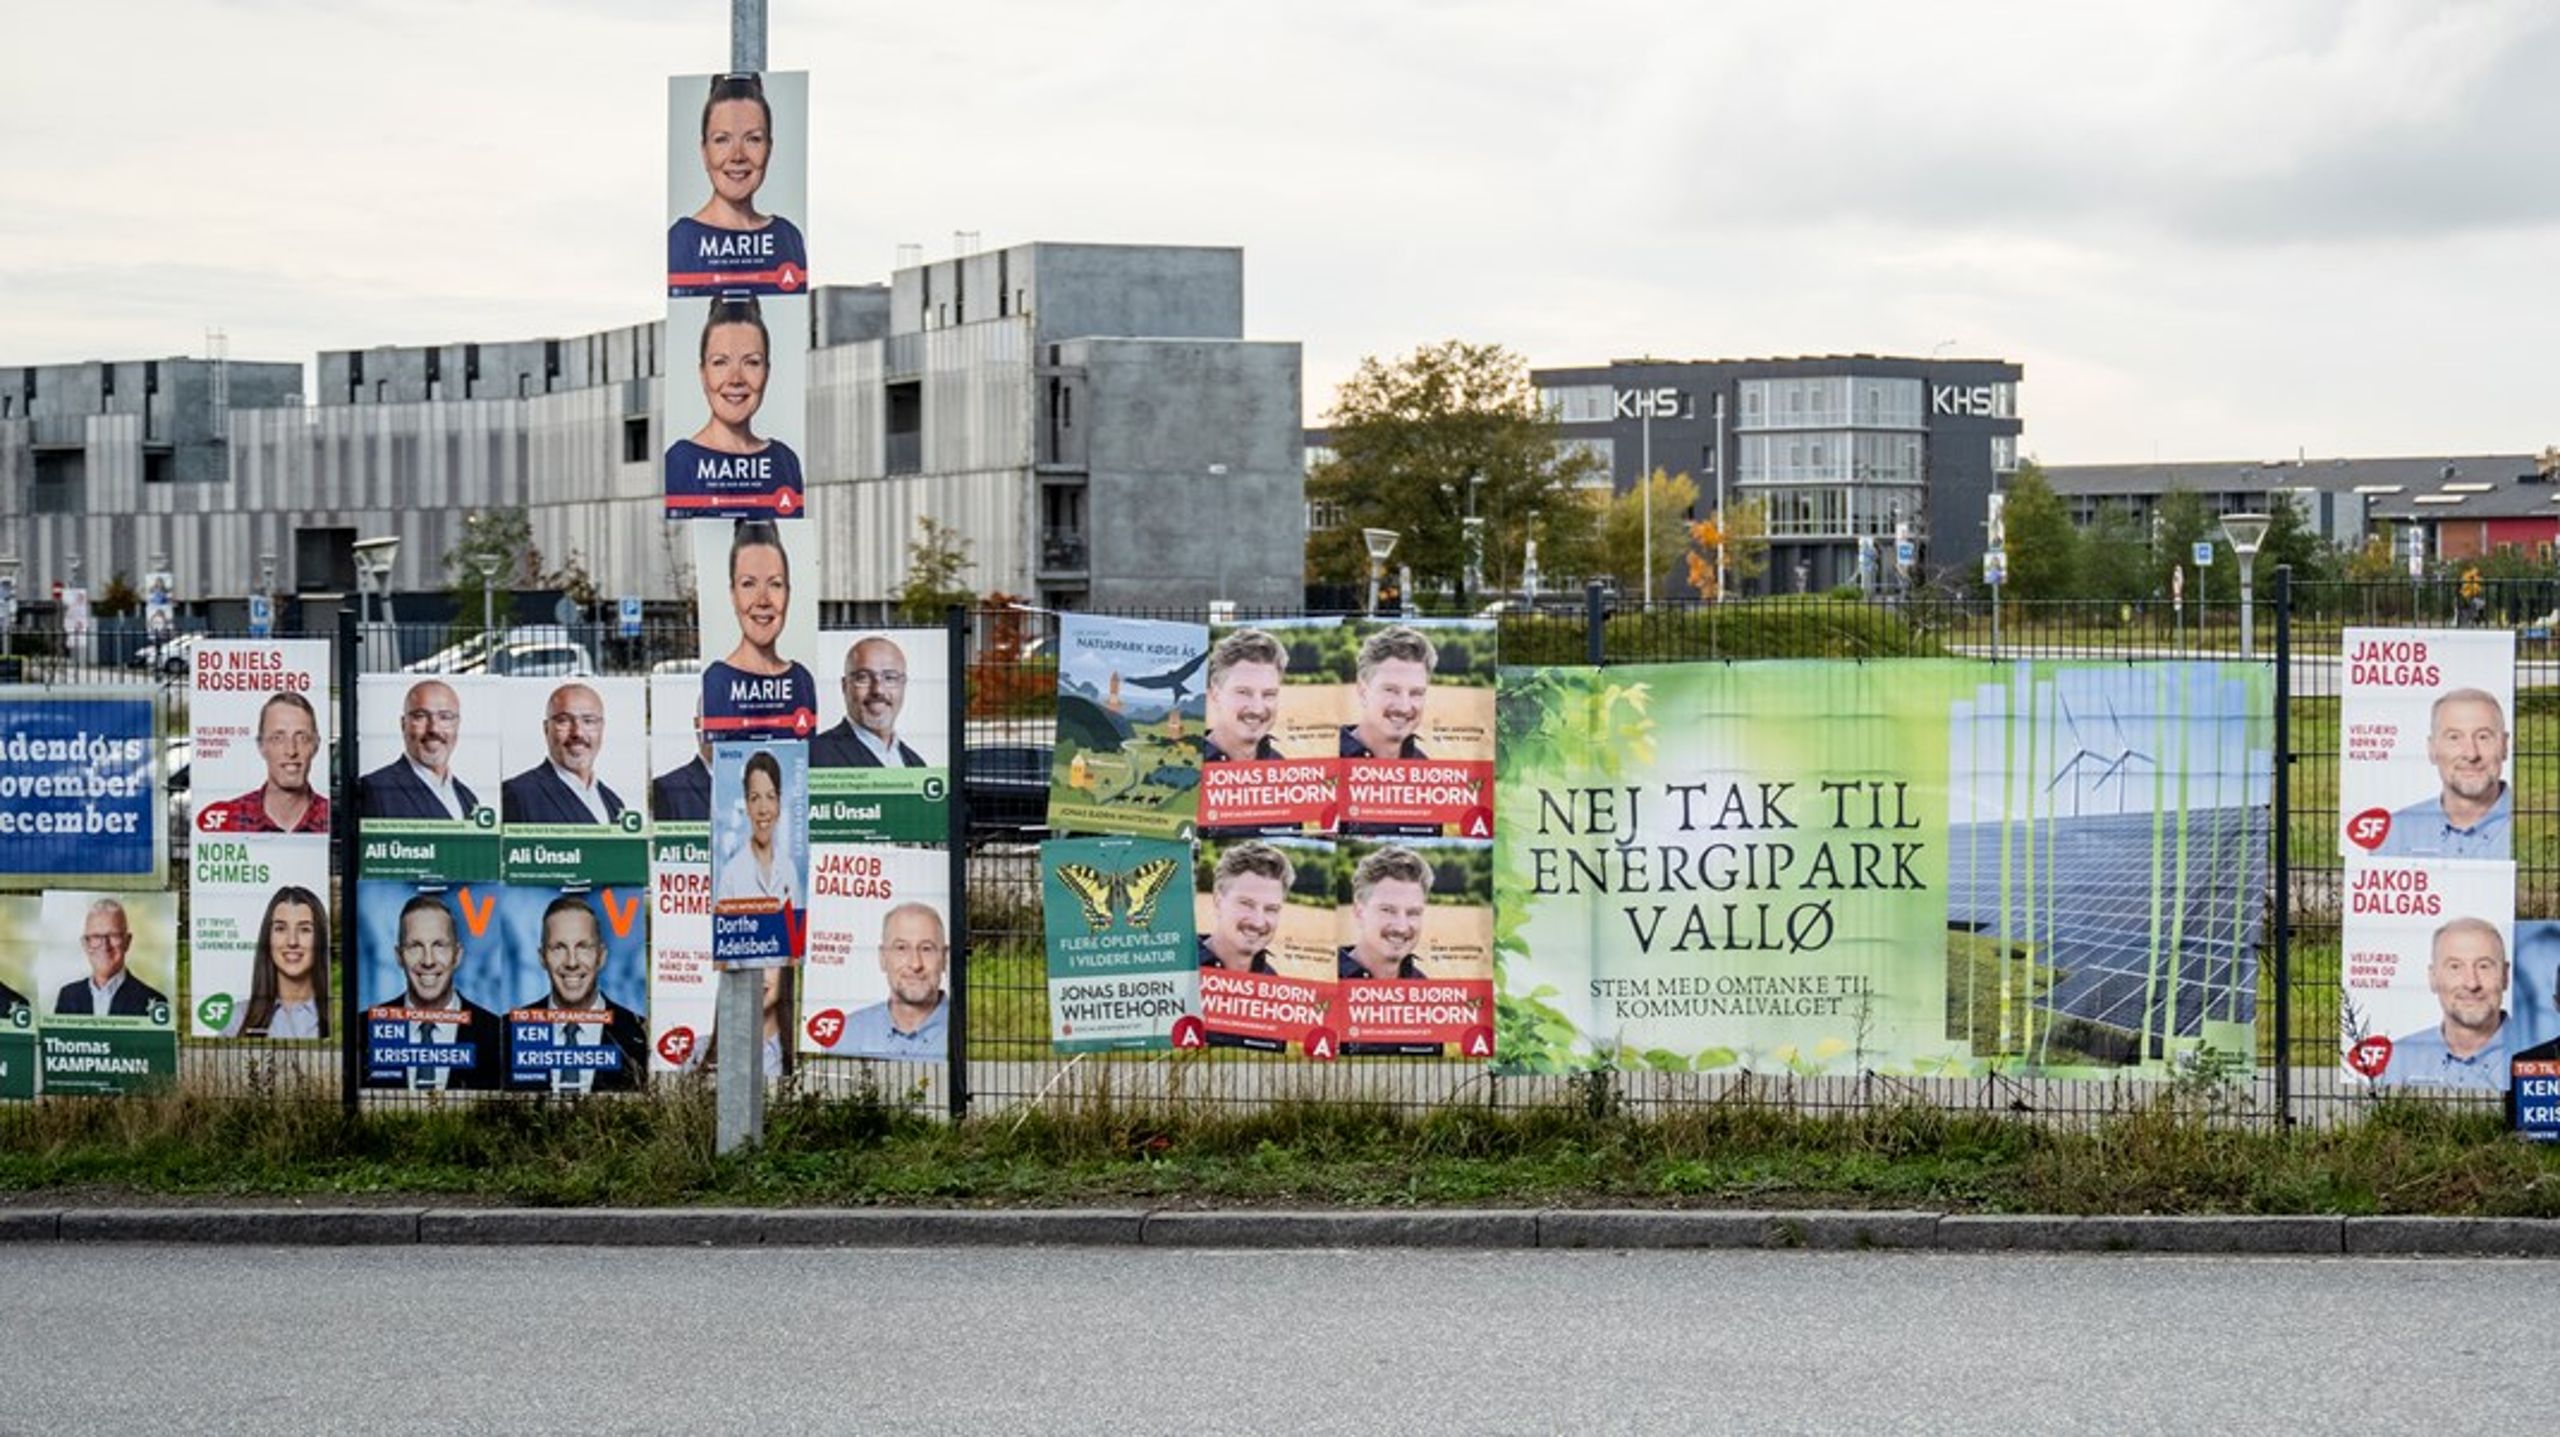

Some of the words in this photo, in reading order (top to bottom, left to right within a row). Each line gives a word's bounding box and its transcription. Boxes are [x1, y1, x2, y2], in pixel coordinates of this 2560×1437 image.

[699, 233, 774, 257] MARIE
[782, 268, 795, 284] A
[1614, 388, 1680, 419] KHS
[1932, 385, 1993, 416] KHS
[697, 458, 771, 479] MARIE
[779, 493, 791, 508] A
[1076, 638, 1145, 653] NATURPARK
[2351, 641, 2427, 663] JAKOB
[198, 651, 223, 670] BO
[229, 651, 282, 670] NIELS
[197, 672, 310, 691] ROSENBERG
[2351, 665, 2440, 687] DALGAS
[730, 679, 793, 701] MARIE
[796, 714, 807, 728] A
[2349, 750, 2388, 761] KULTUR
[1206, 768, 1263, 786] JONAS
[1266, 765, 1325, 783] BJØRN
[1349, 766, 1406, 783] JONAS
[1410, 767, 1468, 784] BJØRN
[927, 781, 940, 796] C
[1206, 784, 1337, 806] WHITEHORN
[1349, 784, 1478, 806] WHITEHORN
[203, 810, 228, 829] SF
[479, 809, 492, 826] C
[808, 804, 830, 820] Ali
[834, 801, 881, 820] Ünsal
[1537, 786, 1642, 844] NEJ
[1666, 781, 1797, 830] TAK
[1820, 780, 1920, 828] TIL
[626, 815, 637, 830] C
[1471, 815, 1488, 836] A
[2355, 819, 2386, 839] SF
[198, 844, 248, 862] NORA
[365, 843, 387, 859] Ali
[389, 840, 436, 859] Ünsal
[509, 848, 531, 864] Ali
[534, 844, 581, 864] Ünsal
[659, 845, 681, 861] Ali
[684, 843, 709, 861] Ün
[197, 865, 269, 883] CHMEIS
[816, 854, 882, 877] JAKOB
[1530, 841, 1927, 895] ENERGIPARK
[659, 874, 710, 893] NORA
[816, 875, 892, 899] DALGAS
[2352, 870, 2428, 892] JAKOB
[458, 887, 495, 938] V
[602, 888, 639, 938] V
[2352, 893, 2441, 915] DALGAS
[717, 917, 759, 933] Dorthe
[1623, 899, 1835, 954] VALLØ
[717, 936, 779, 956] Adelsbech
[1060, 938, 1098, 950] FLERE
[1101, 932, 1180, 948] OPLEVELSER
[1076, 953, 1130, 967] VILDERE
[1133, 951, 1176, 964] NATUR
[1060, 984, 1114, 1001] JONAS
[1118, 981, 1174, 998] BJØRN
[1201, 975, 1254, 996] JONAS
[1258, 982, 1316, 1003] BJØRN
[1590, 978, 1650, 998] STEM
[1657, 977, 1711, 997] MED
[1716, 976, 1829, 996] OMTANKE
[1835, 976, 1874, 995] TIL
[2350, 979, 2389, 988] KULTUR
[1349, 987, 1405, 1003] JONAS
[1409, 986, 1468, 1003] BJØRN
[16, 1010, 27, 1025] C
[154, 1008, 166, 1022] C
[204, 1001, 228, 1021] SF
[1061, 999, 1186, 1021] WHITEHORN
[1201, 995, 1324, 1025] WHITEHORN
[1349, 1005, 1478, 1024] WHITEHORN
[1615, 998, 1842, 1019] KOMMUNALVALGET
[373, 1024, 405, 1039] KEN
[516, 1026, 549, 1041] KEN
[814, 1018, 840, 1037] SF
[1182, 1026, 1199, 1046] A
[44, 1037, 111, 1055] Thomas
[665, 1036, 689, 1056] SF
[1313, 1036, 1331, 1058] A
[1472, 1034, 1489, 1055] A
[46, 1057, 149, 1074] KAMPMANN
[374, 1048, 470, 1064] KRISTENSEN
[517, 1050, 616, 1065] KRISTENSEN
[2356, 1047, 2387, 1067] SF
[2523, 1080, 2559, 1096] KEN
